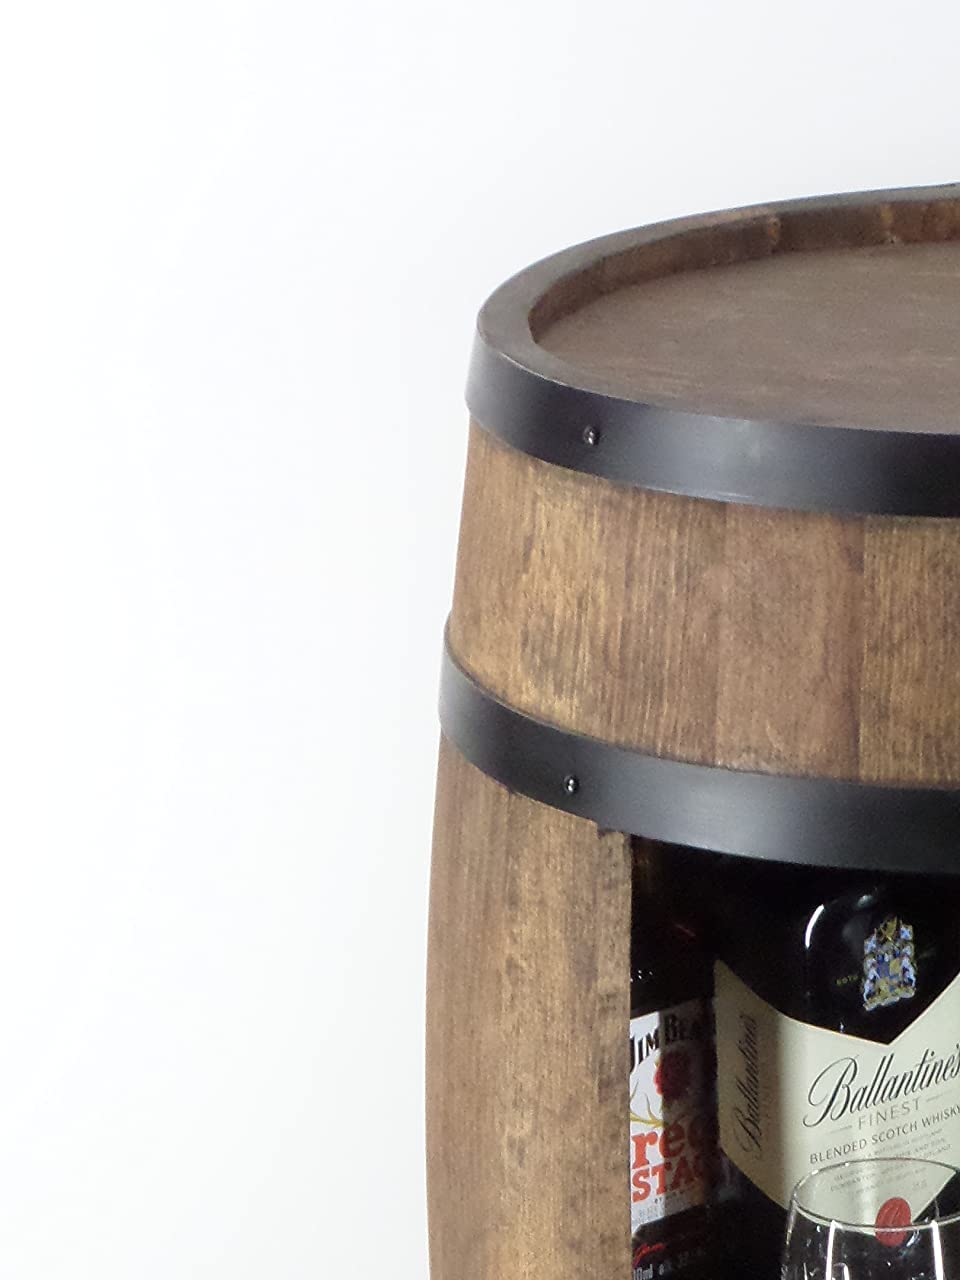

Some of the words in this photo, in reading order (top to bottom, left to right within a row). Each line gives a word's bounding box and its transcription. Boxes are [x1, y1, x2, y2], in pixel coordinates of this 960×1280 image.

[857, 1098, 921, 1131] FINEST
[809, 1138, 867, 1164] BLENDED
[871, 1123, 918, 1146] SCOTCH
